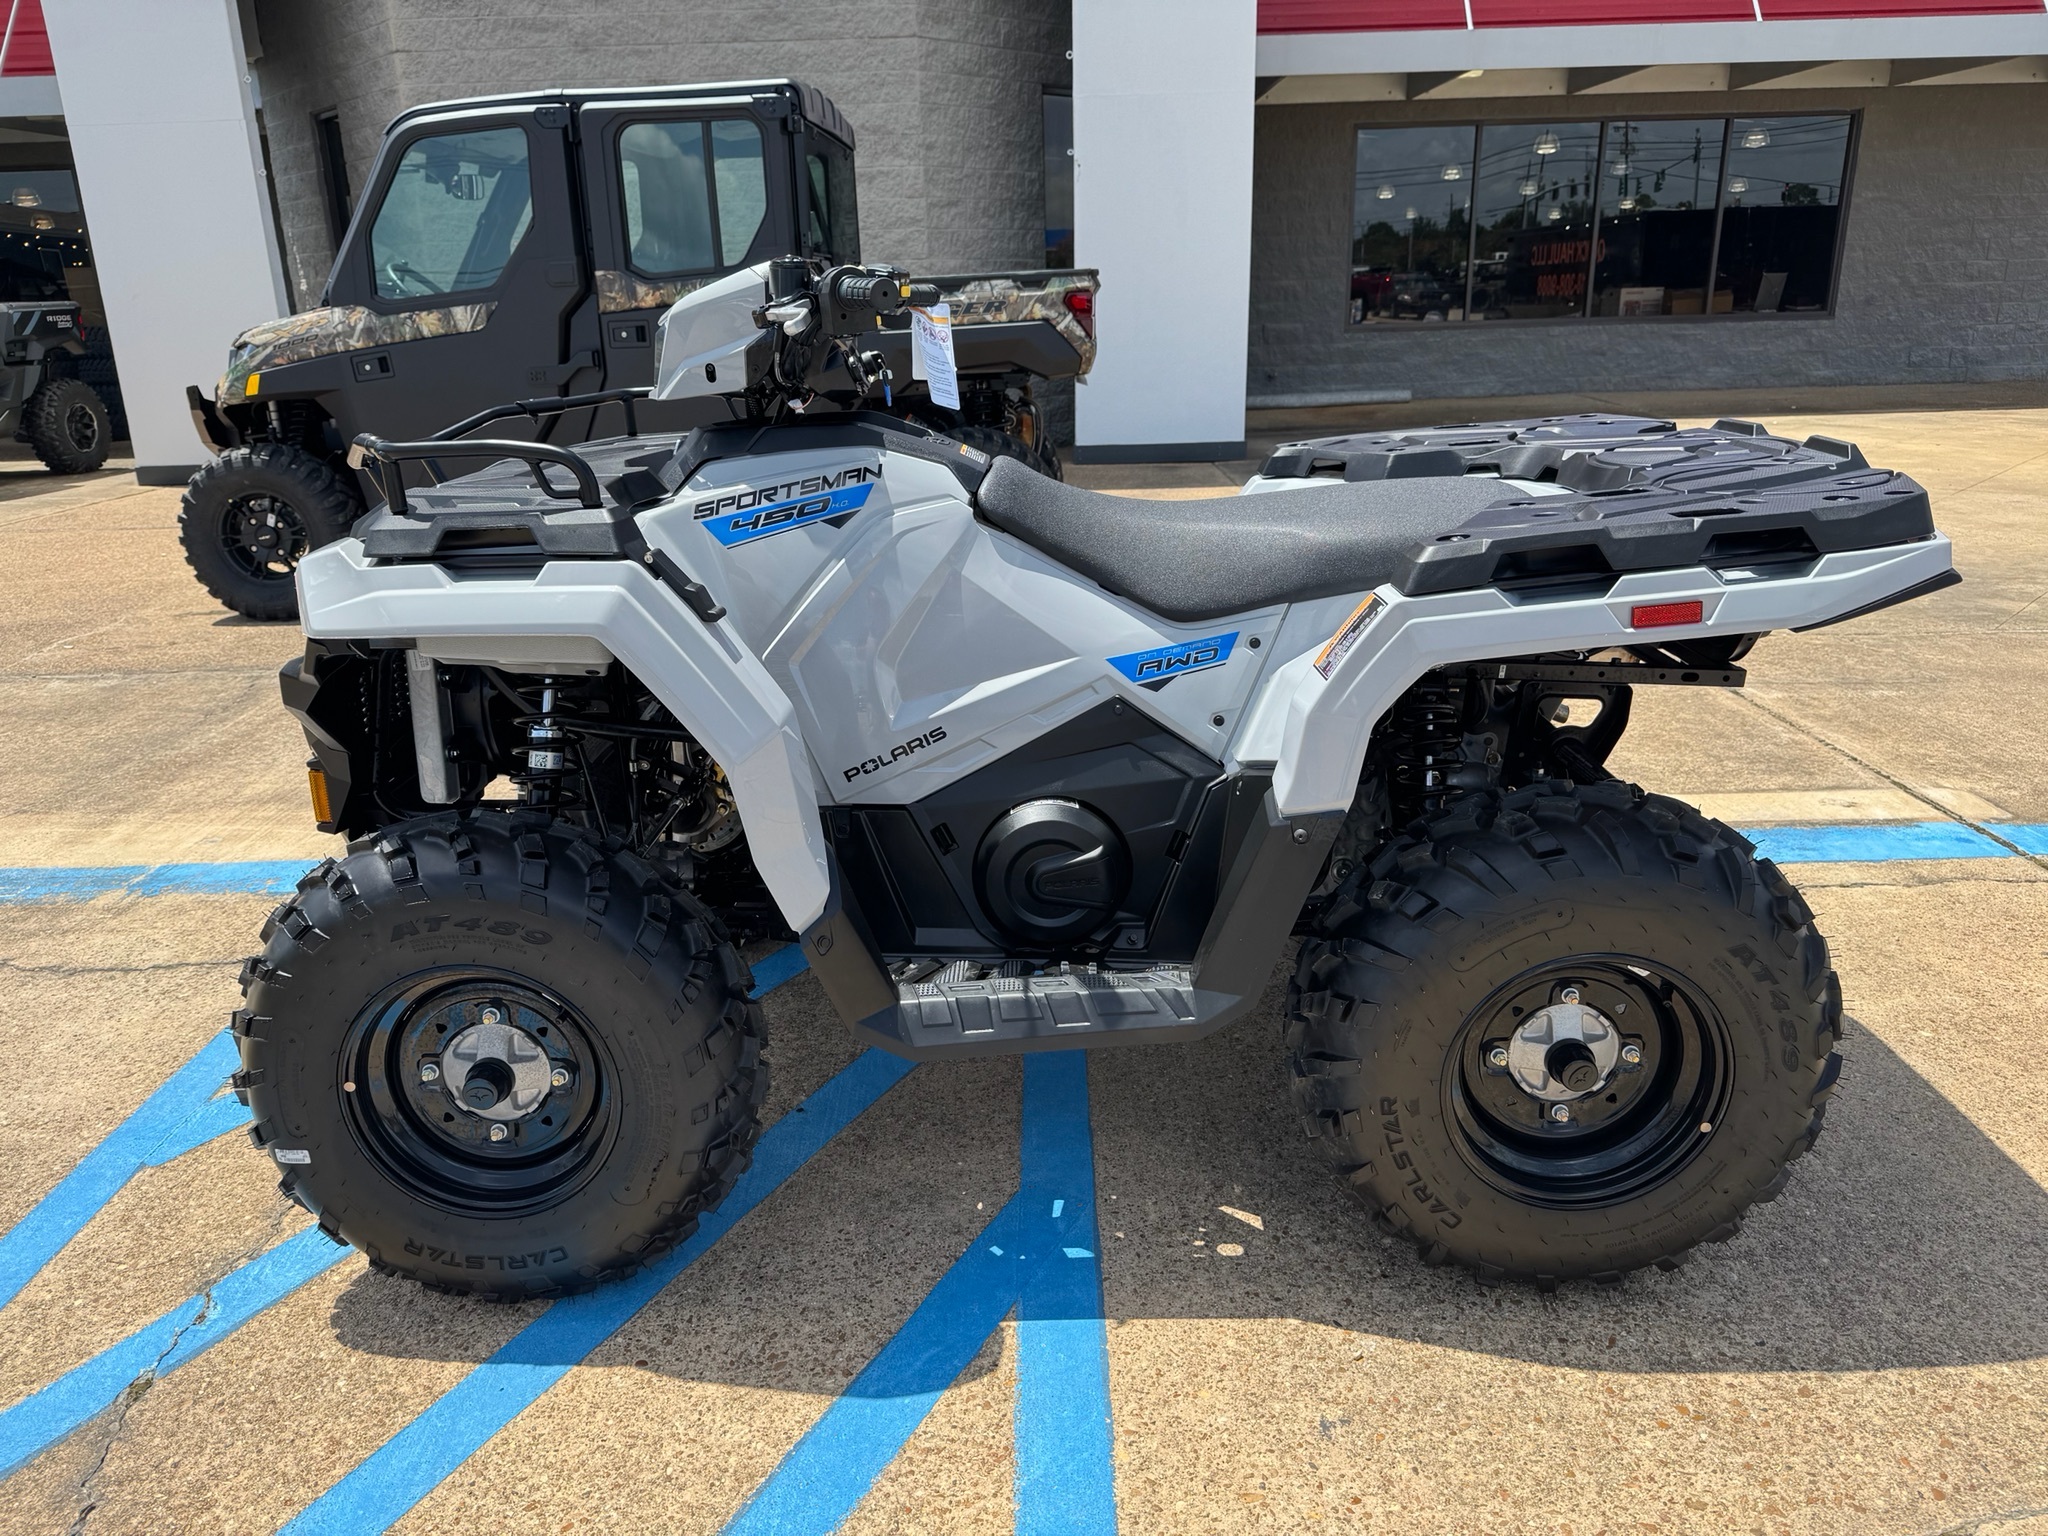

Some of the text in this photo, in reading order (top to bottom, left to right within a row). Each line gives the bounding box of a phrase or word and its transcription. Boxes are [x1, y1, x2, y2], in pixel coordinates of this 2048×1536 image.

[273, 333, 319, 351] 1000
[693, 463, 882, 520] SPORTSMAN
[730, 496, 833, 532] 450
[1136, 646, 1220, 677] AWD
[1137, 638, 1221, 661] ON DEMAND
[843, 725, 947, 783] POLARIS
[1044, 877, 1100, 891] POLARIS
[1379, 1096, 1462, 1229] CARLSTAR
[404, 1236, 569, 1270] CARLSTAR
